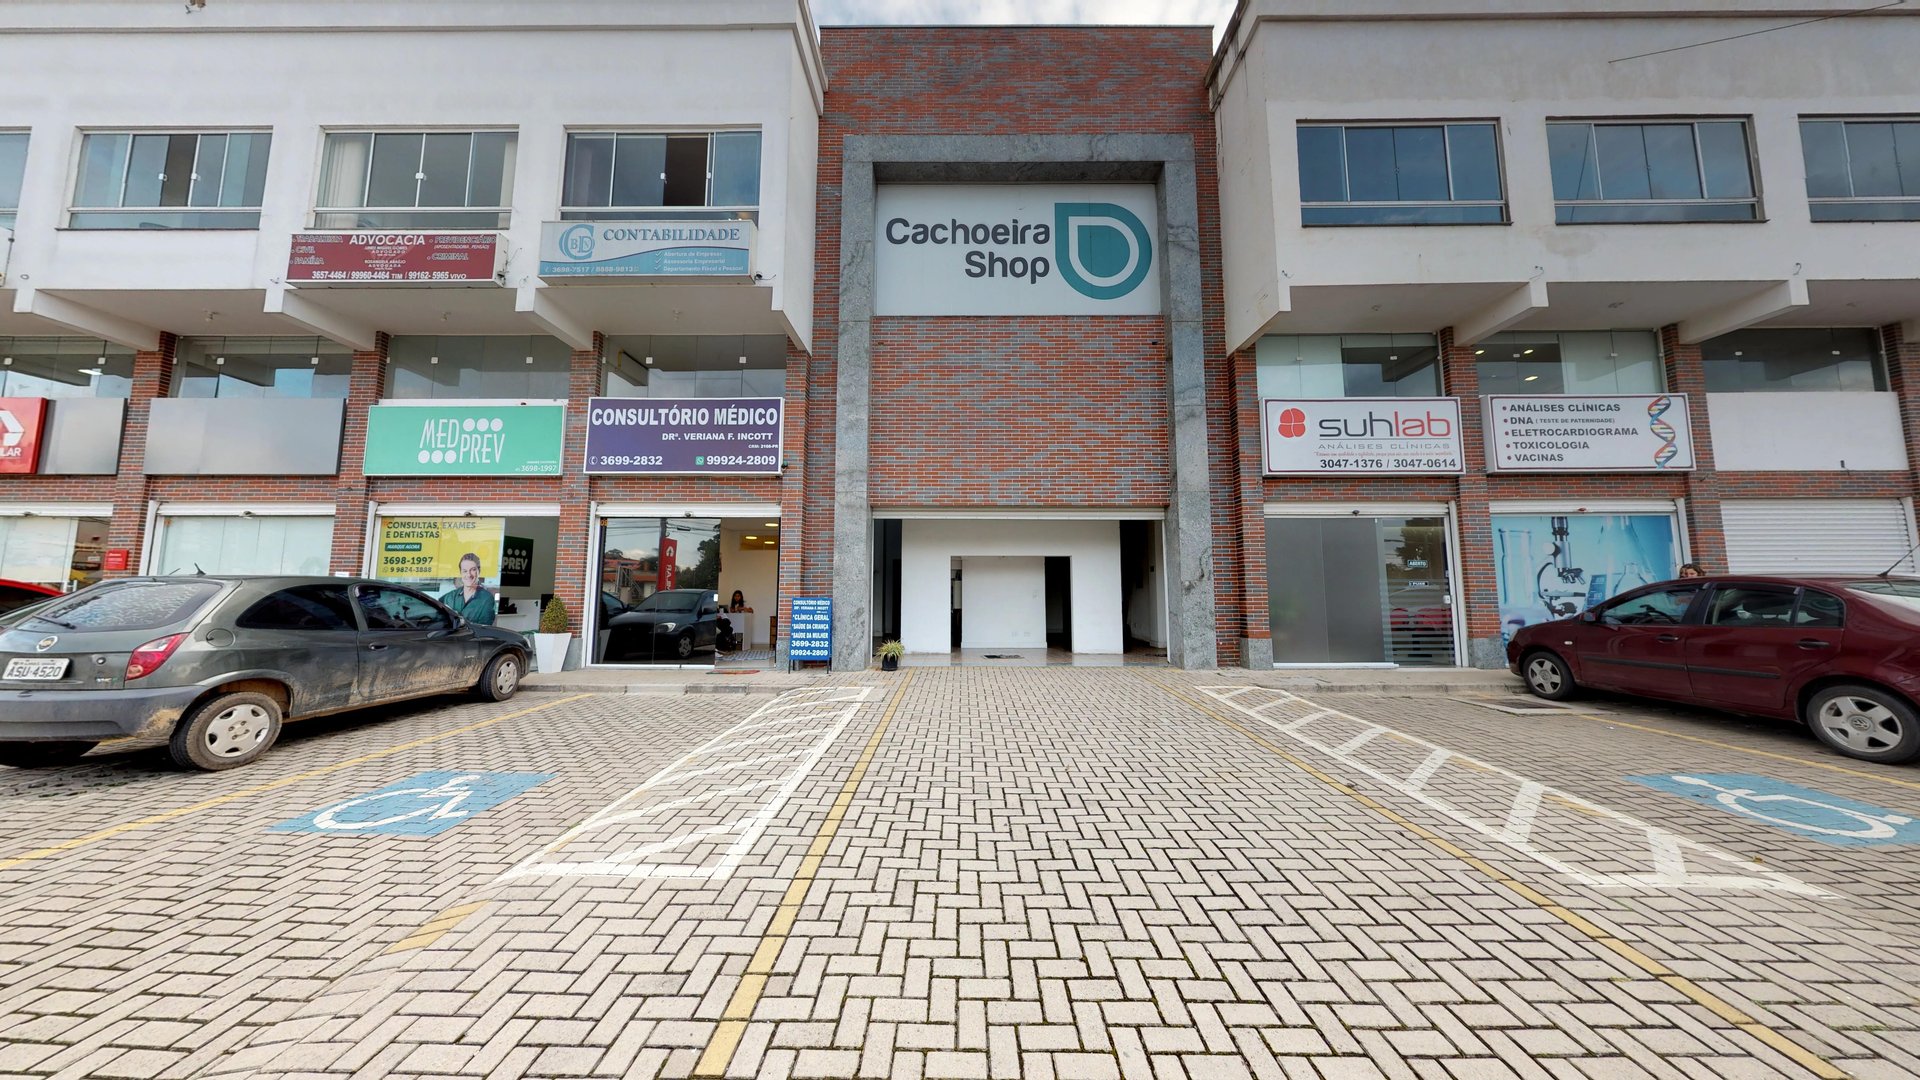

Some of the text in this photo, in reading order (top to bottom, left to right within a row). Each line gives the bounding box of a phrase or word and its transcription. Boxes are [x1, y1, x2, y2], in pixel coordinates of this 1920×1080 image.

[603, 228, 740, 241] CONTABILIDADE
[886, 217, 1050, 245] Cachoeira
[349, 234, 426, 246] ADVOCACIA
[431, 252, 469, 261] CRIMINAL
[965, 250, 1050, 285] Shop
[311, 271, 347, 280] 3657-4464
[1509, 402, 1621, 412] ANÁLISES CLÍNICAS
[591, 403, 778, 426] CONSULTÓRIO MÉDICO
[1318, 411, 1451, 437] suhlab
[1510, 416, 1534, 425] DNA
[419, 418, 460, 449] MED
[684, 433, 725, 441] VERIANA
[727, 433, 735, 441] F.
[737, 432, 773, 441] INCOTT
[1511, 427, 1639, 437] ELETROCARDIOGRAMA
[459, 433, 506, 464] PREV
[1318, 441, 1450, 450] ANÁLISES CLÍNICAS
[1513, 441, 1590, 450] TOXICOLOGIA
[600, 455, 776, 466] 3699-2832 99924-2809
[1514, 453, 1564, 462] VACINAS
[521, 464, 557, 472] 3698-1997
[1320, 458, 1383, 468] 3047-1376
[1393, 458, 1457, 468] 3047-0614
[387, 521, 440, 530] CONSULTAS,
[442, 521, 476, 529] EXAMES
[385, 530, 391, 538] E
[383, 556, 433, 565] 3698-1997
[502, 557, 528, 570] PREV
